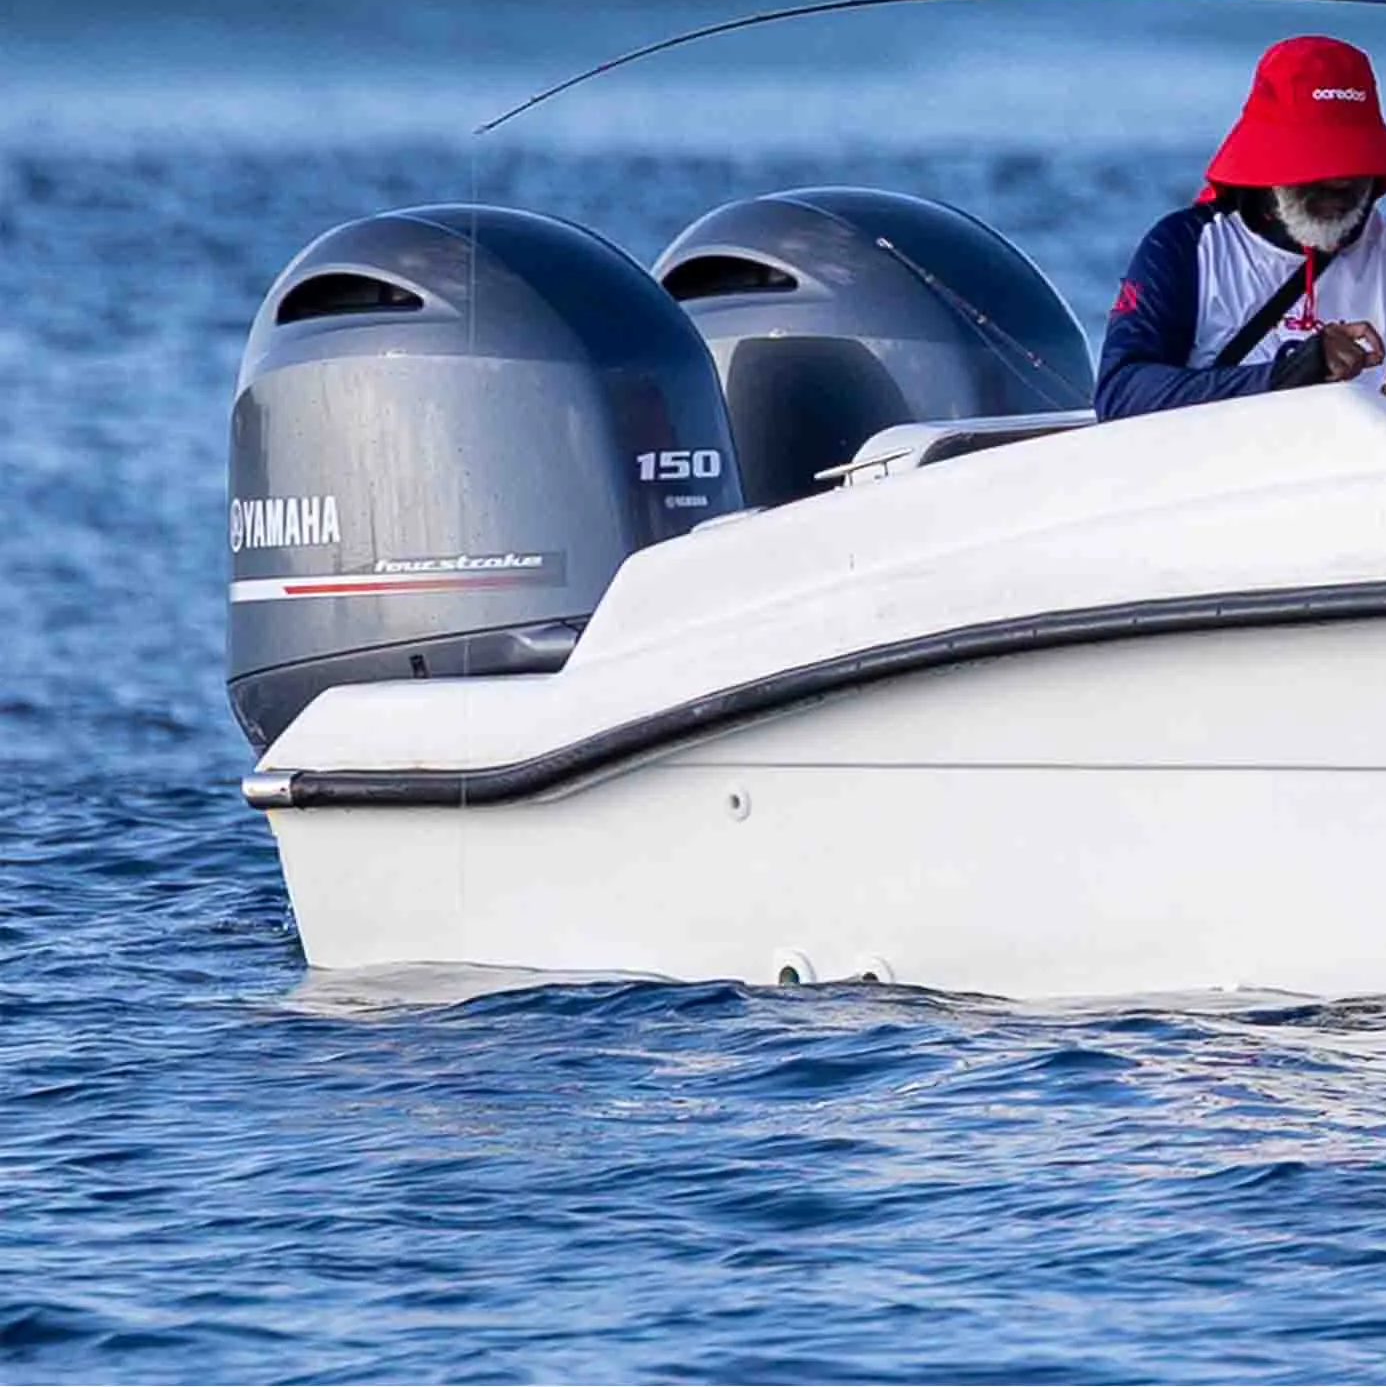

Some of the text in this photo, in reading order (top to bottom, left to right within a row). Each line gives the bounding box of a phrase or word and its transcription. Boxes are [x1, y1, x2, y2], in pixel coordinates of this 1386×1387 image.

[1312, 88, 1366, 102] ooredoo
[637, 450, 720, 481] 150
[243, 496, 340, 549] YAMAHA
